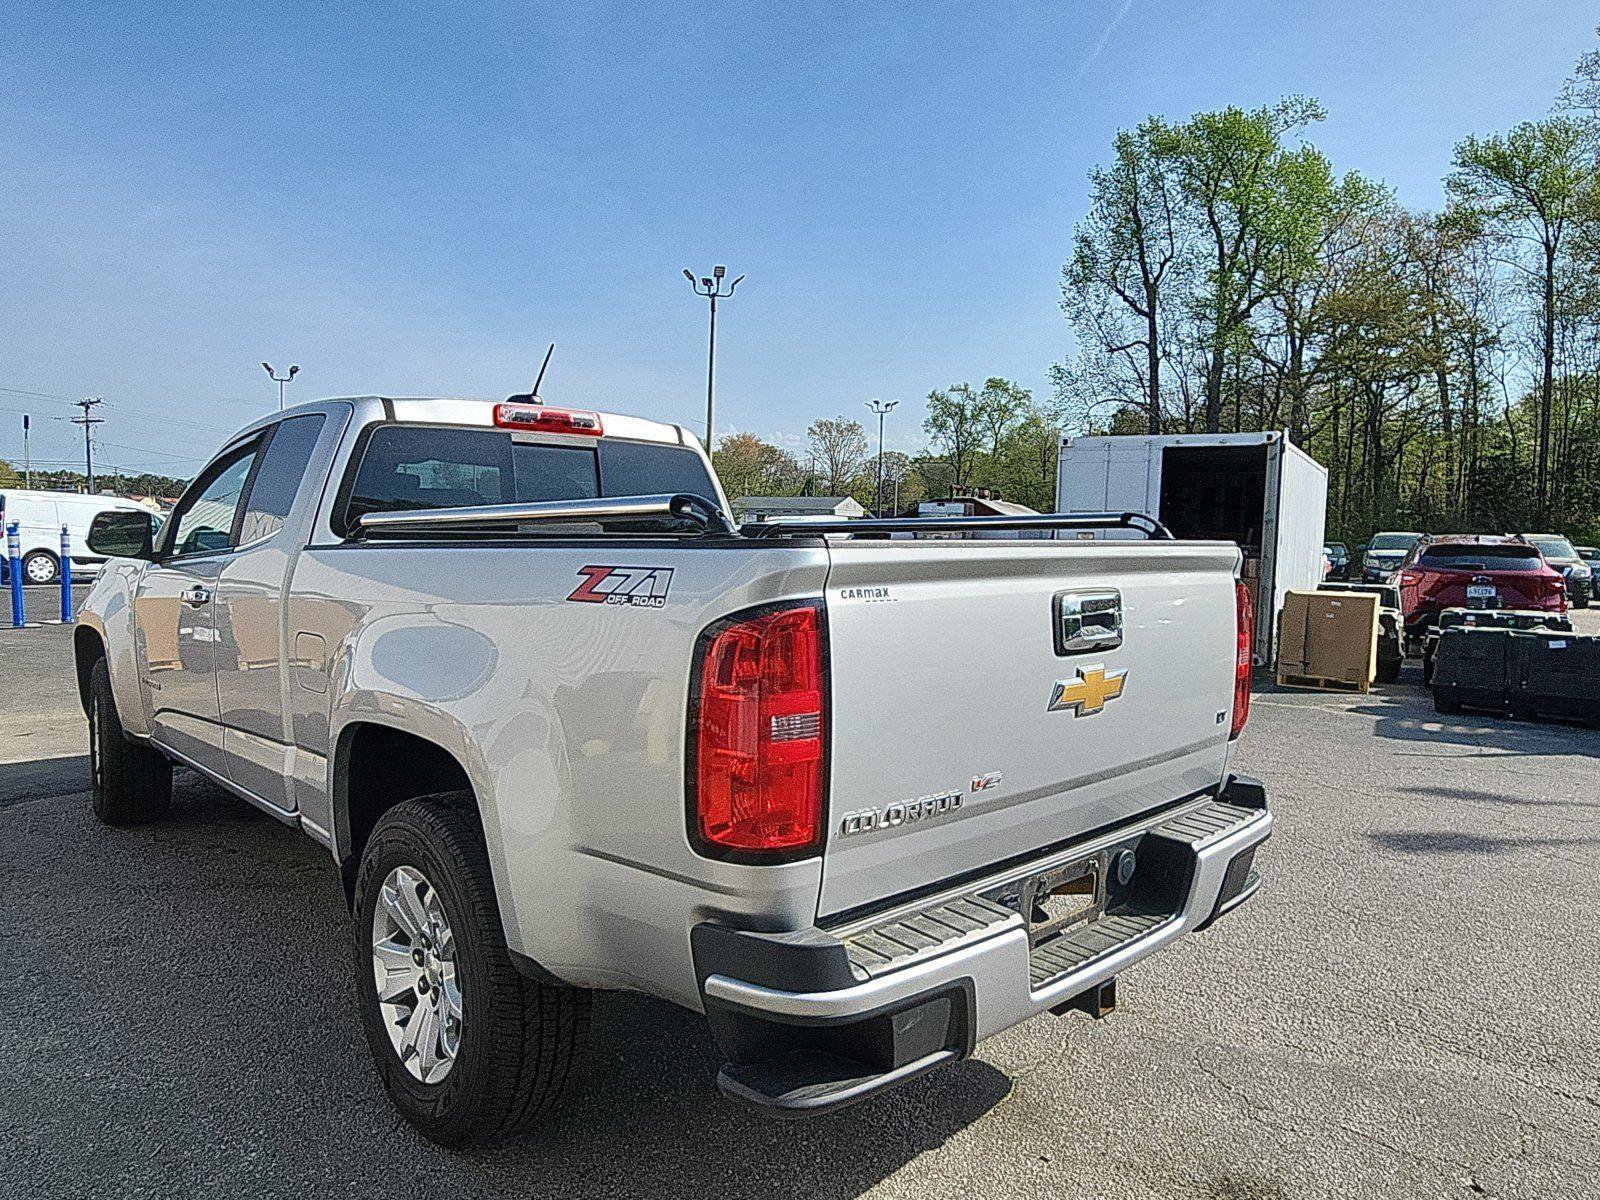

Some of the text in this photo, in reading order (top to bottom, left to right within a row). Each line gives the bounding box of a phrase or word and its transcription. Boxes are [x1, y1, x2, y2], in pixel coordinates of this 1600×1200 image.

[566, 565, 674, 603] Z71
[607, 594, 665, 607] OFF ROAD
[839, 790, 964, 836] COLORADO
